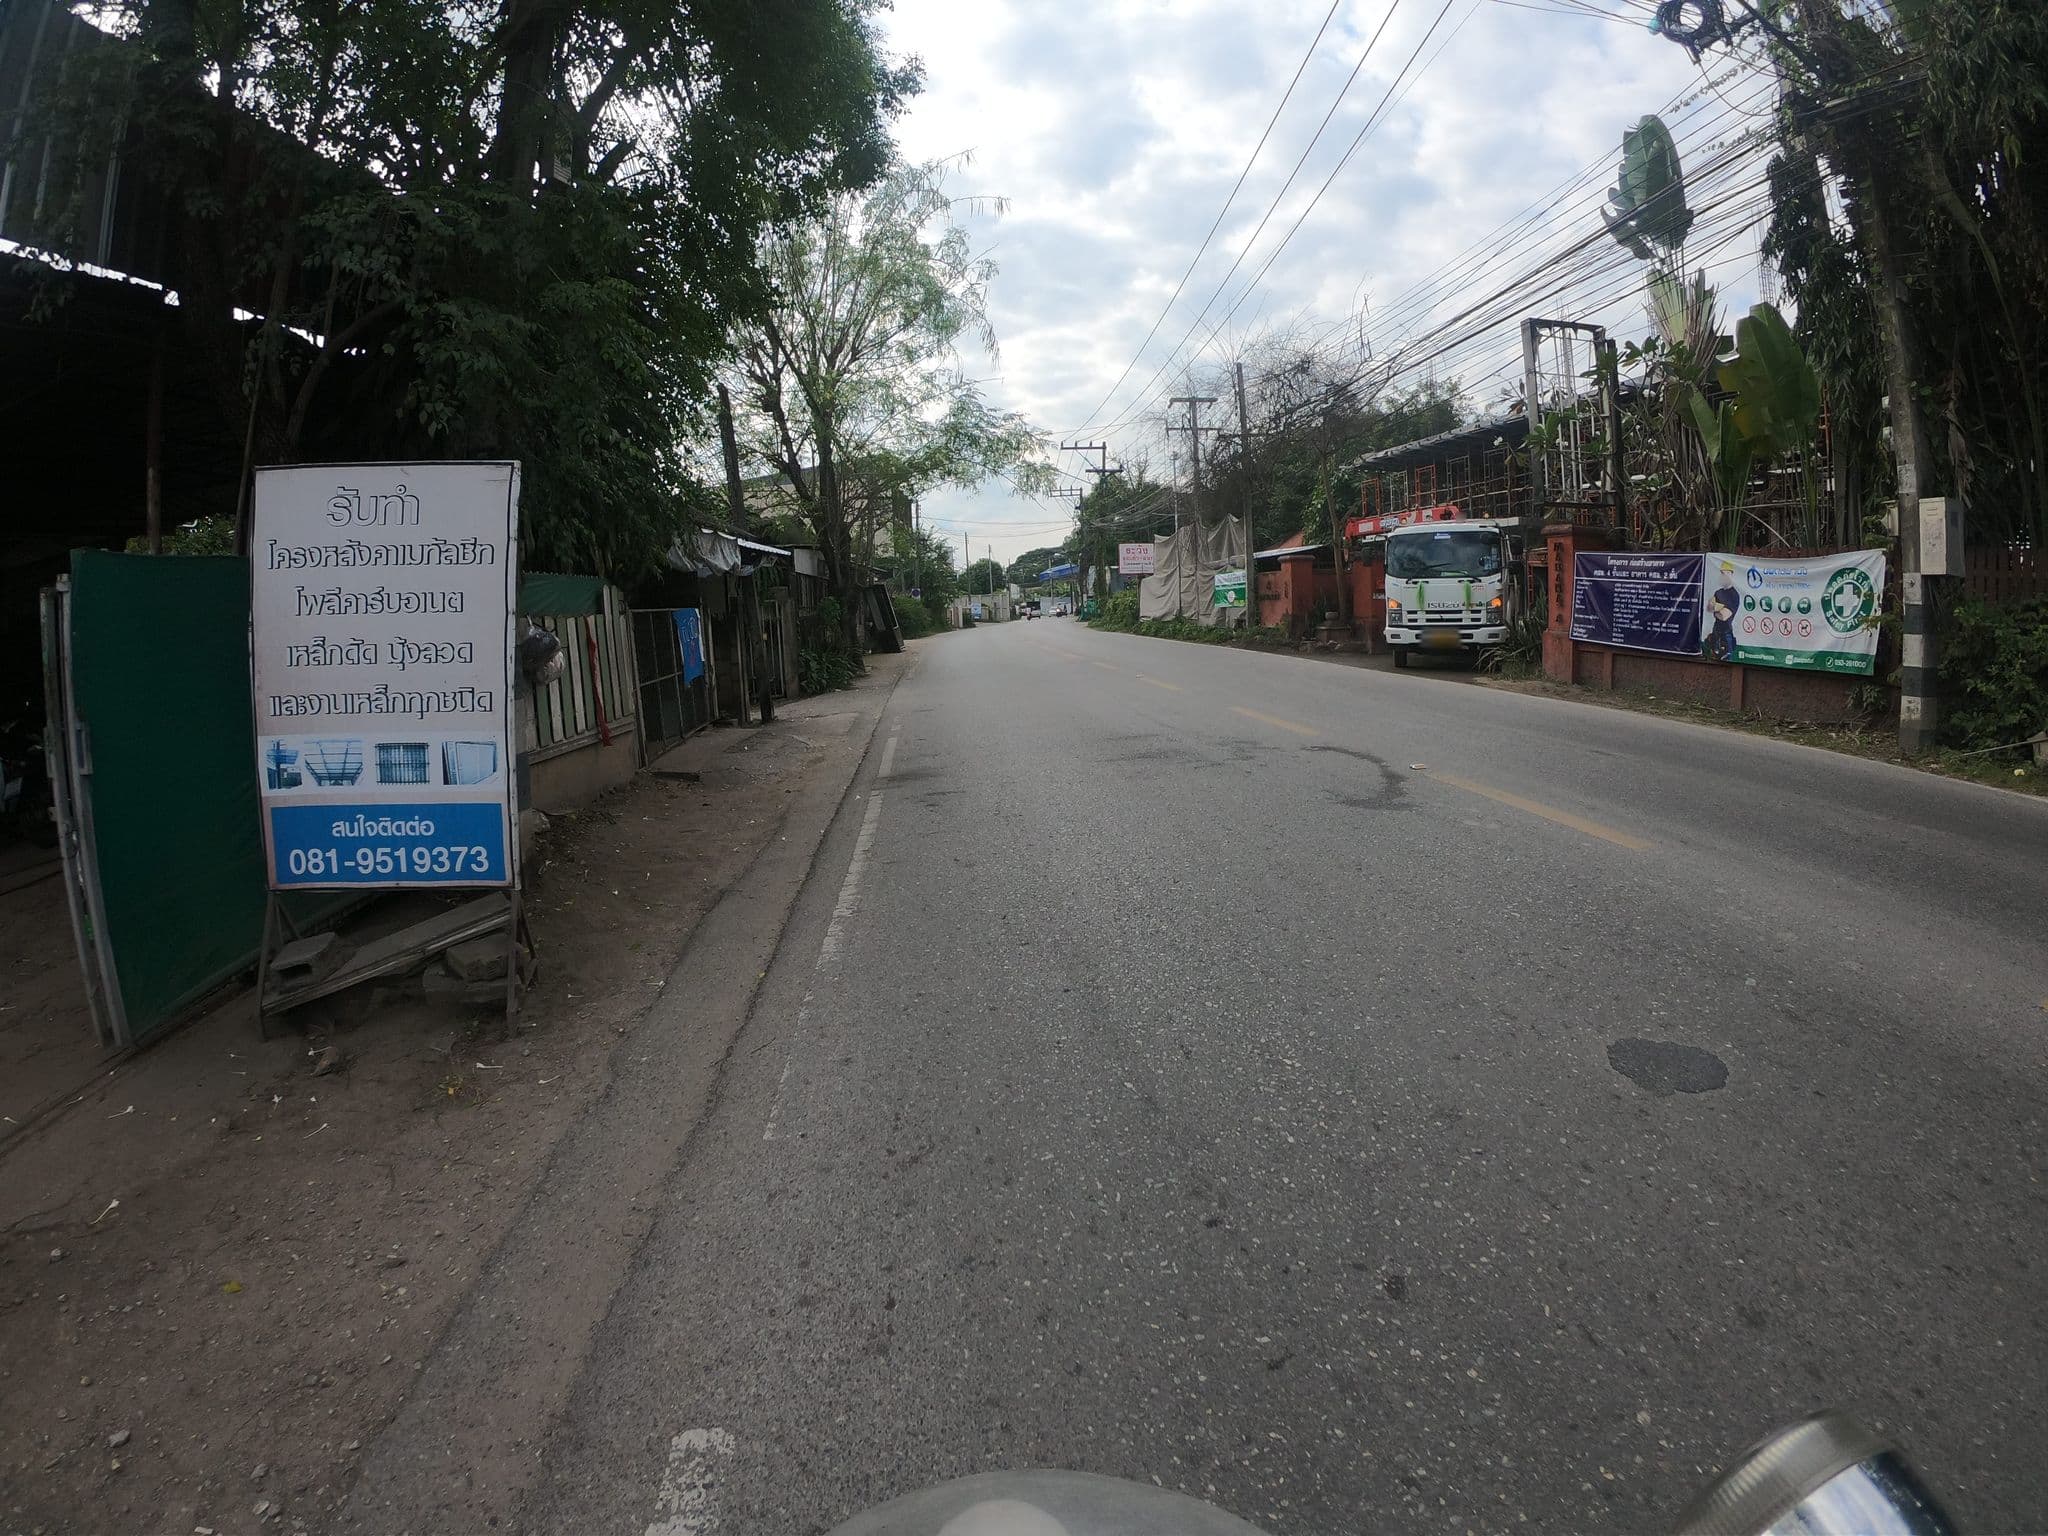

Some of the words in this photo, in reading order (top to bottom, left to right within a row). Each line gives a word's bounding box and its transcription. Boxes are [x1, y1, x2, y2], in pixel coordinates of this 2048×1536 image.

[326, 484, 421, 527] รับทำ
[295, 586, 464, 617] โพลีคาร์บอเนต
[1427, 601, 1460, 609] ISUZU
[286, 636, 378, 667] เหล็กดัด
[387, 636, 474, 671] มุ้งลวด
[269, 684, 494, 720] และงานเหล็กทุกชนิด
[331, 814, 436, 839] สนใจติดต่อ
[288, 845, 491, 876] 081-9519373
